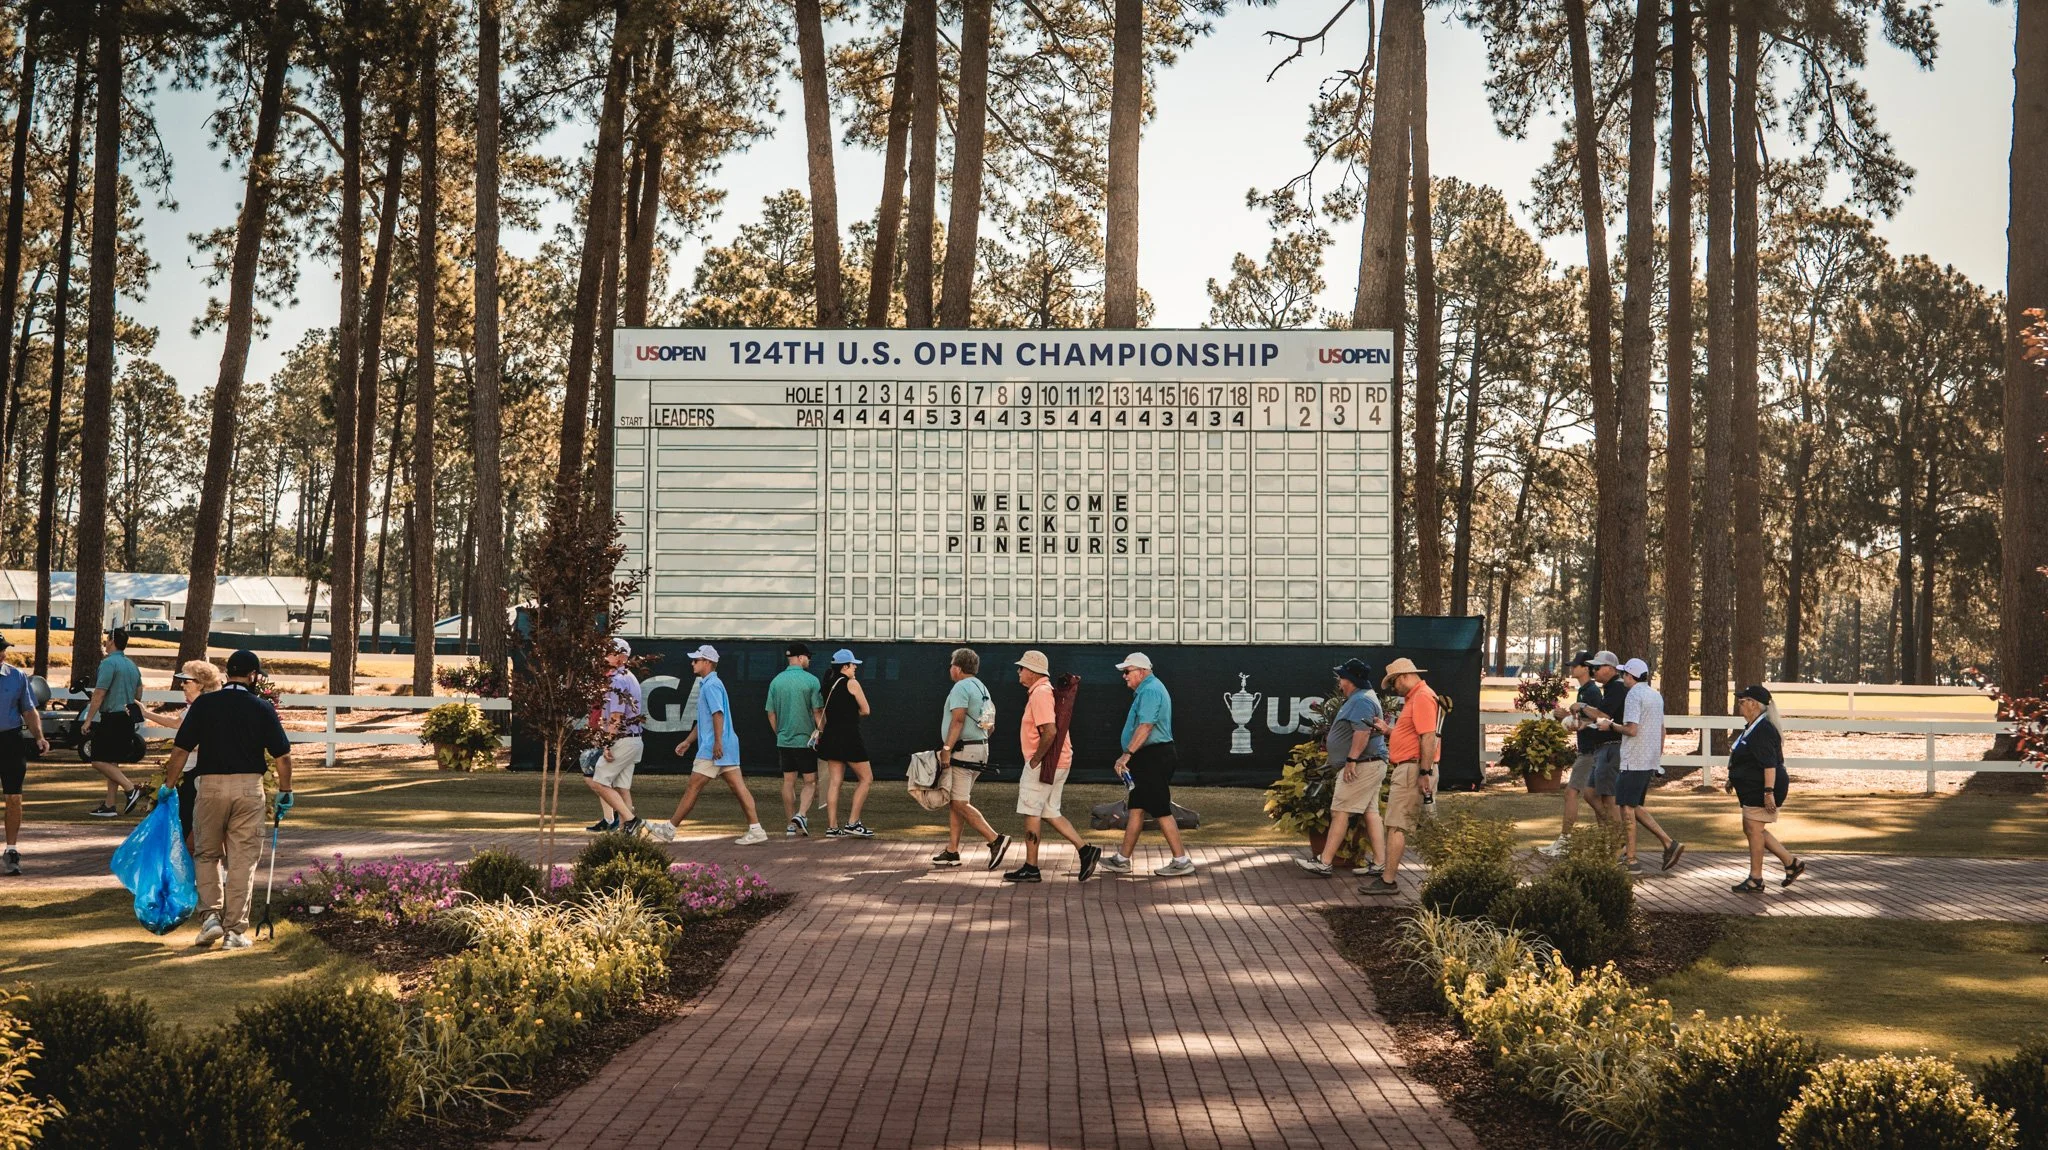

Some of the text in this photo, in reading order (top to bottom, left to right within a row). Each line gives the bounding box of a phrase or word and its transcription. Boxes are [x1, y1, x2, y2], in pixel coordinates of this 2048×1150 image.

[730, 341, 1278, 366] 124TH U.S. OPEN CHAMPIONSHIP
[786, 384, 1248, 405] HOLE 1 2 3 4 5 6 7 8 9 10 11 12 13 14 15 16 17 18
[1257, 387, 1280, 402] RD
[1294, 387, 1317, 402] RD
[1329, 387, 1352, 403] RD
[1365, 387, 1388, 403] RD
[621, 416, 643, 425] START
[655, 408, 714, 426] LEADERS
[797, 409, 1244, 427] PAR 4 4 4 4 5 3 4 4 3 5 4 4 4 4 3 4 3 4
[1263, 406, 1271, 426] 1
[1299, 407, 1311, 426] 2
[1333, 405, 1346, 425] 3
[1368, 406, 1382, 425] 4
[973, 495, 1128, 511] WELCOME
[973, 516, 1129, 532] BACK TO
[948, 537, 1150, 553] PINEHURST
